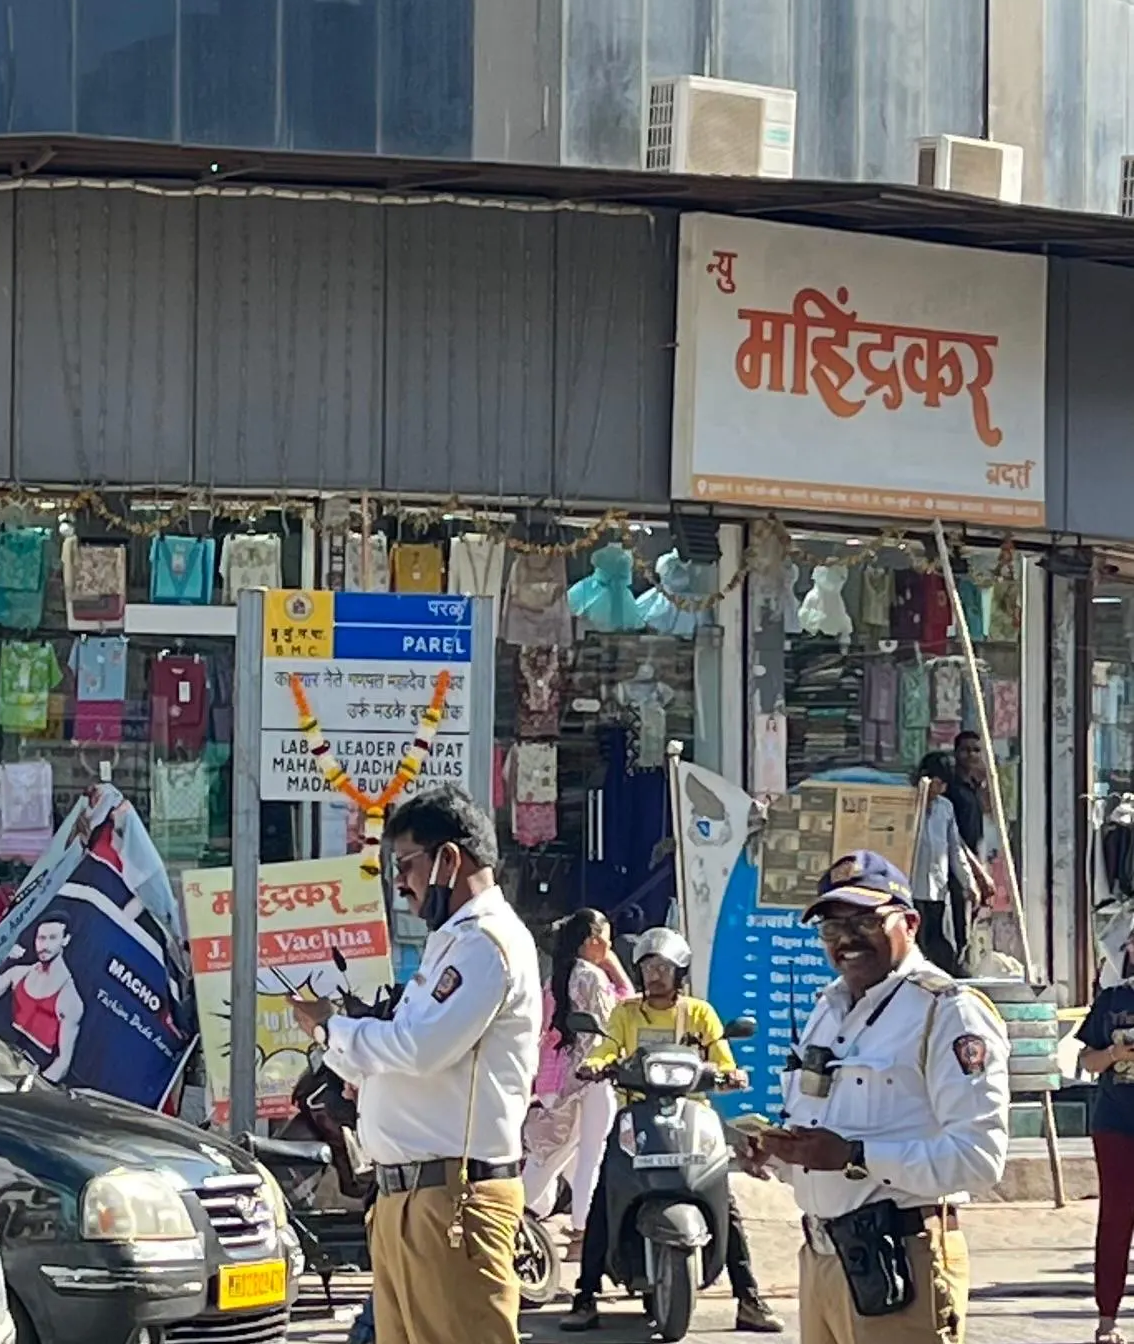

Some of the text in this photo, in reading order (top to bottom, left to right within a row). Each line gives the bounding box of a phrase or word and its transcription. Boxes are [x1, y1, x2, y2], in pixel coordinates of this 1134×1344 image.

[402, 636, 466, 654] PAREL
[337, 740, 395, 757] LEADER
[354, 760, 410, 775] JADHA
[420, 761, 463, 777] ALIAS
[274, 927, 372, 952] Vachha
[108, 958, 161, 1011] MACHO
